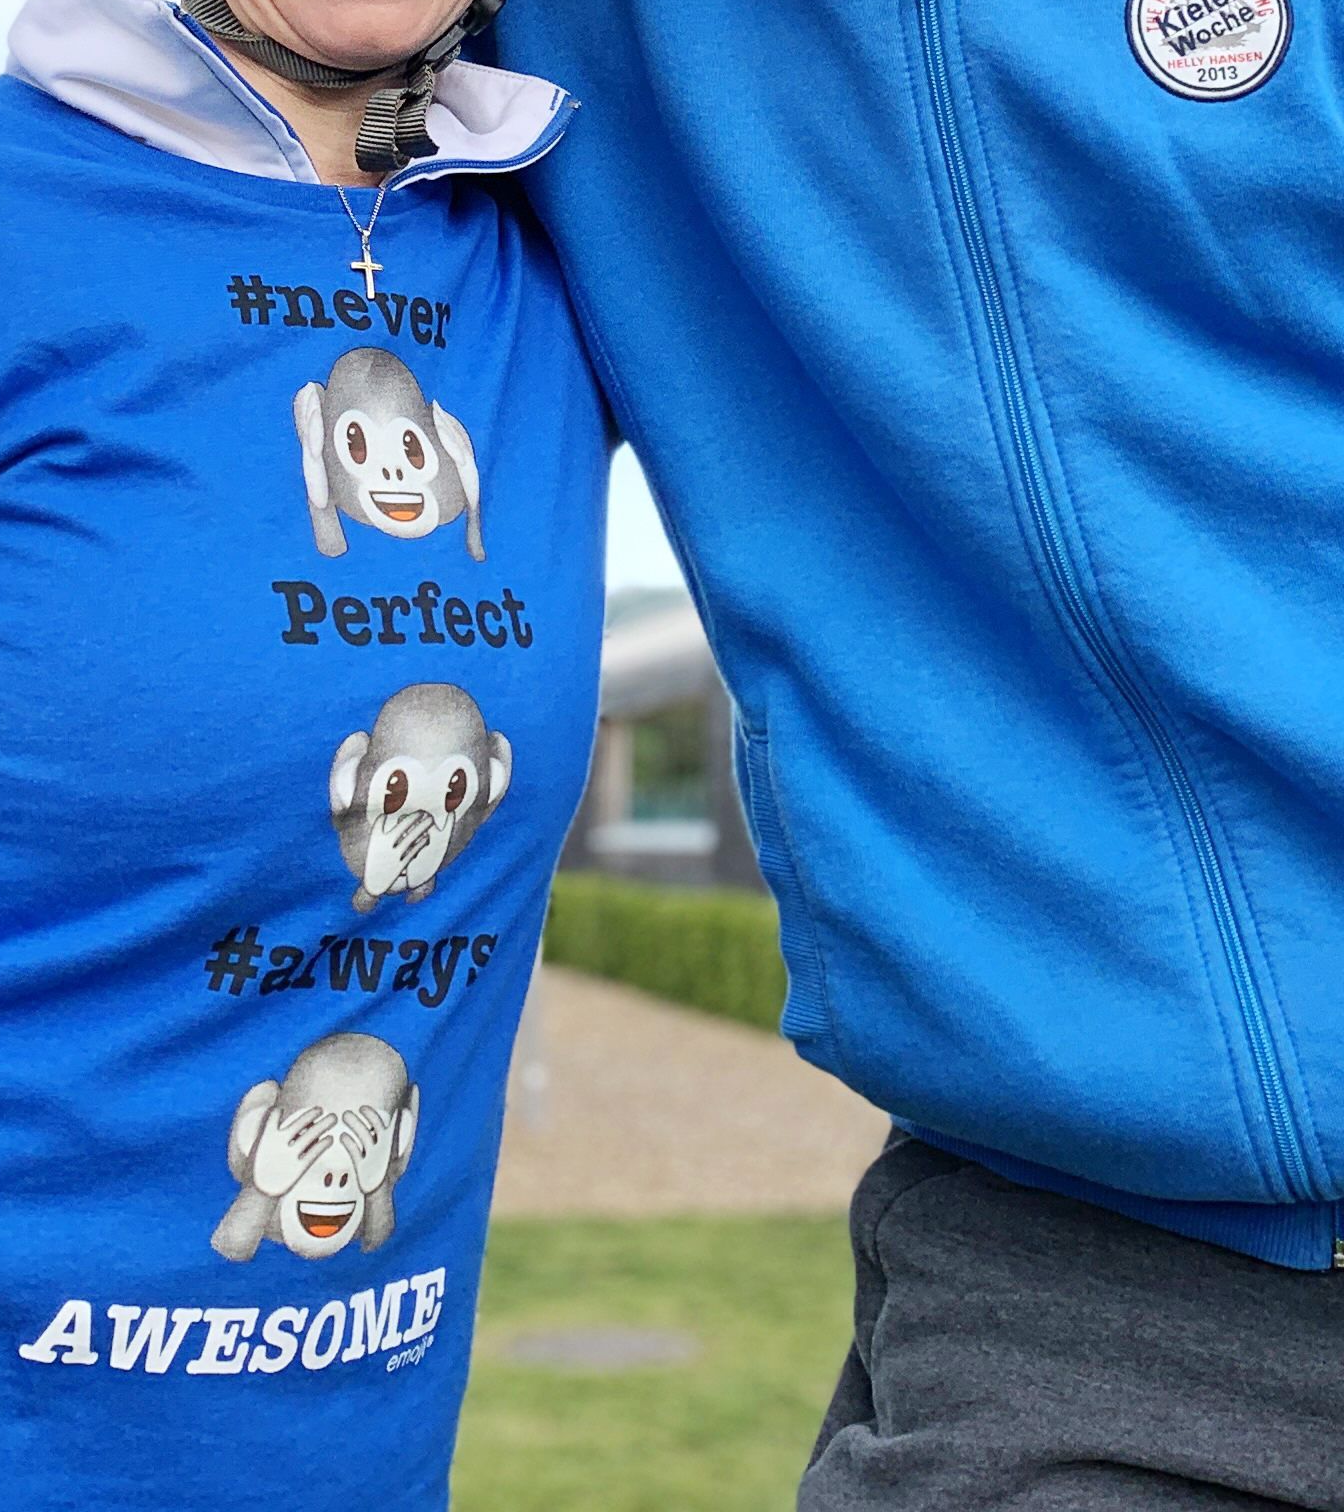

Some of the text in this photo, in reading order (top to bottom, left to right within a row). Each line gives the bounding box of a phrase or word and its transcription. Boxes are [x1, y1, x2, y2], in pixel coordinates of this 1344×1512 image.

[1146, 8, 1163, 32] THE
[1167, 6, 1255, 57] Woche
[1167, 51, 1263, 69] HELLY HANSEN
[1196, 65, 1239, 83] 2013
[227, 274, 451, 349] #never
[272, 580, 534, 649] Perfect
[203, 925, 499, 1008] #always
[18, 1266, 446, 1375] AWESOME
